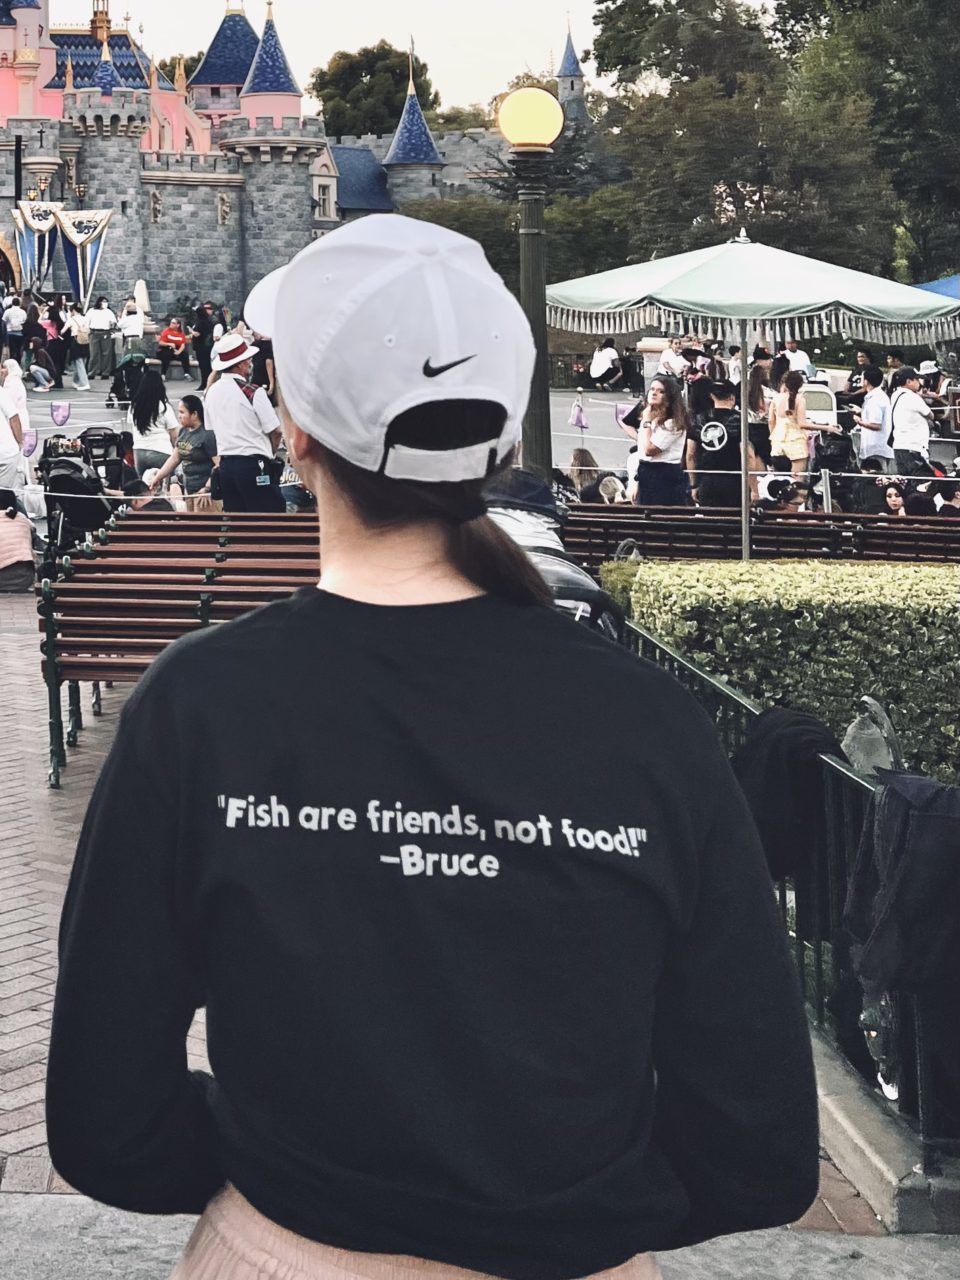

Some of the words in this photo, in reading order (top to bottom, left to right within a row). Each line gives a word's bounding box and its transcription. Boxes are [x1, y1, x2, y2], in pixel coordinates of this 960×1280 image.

[217, 794, 290, 828] "Fish
[298, 805, 358, 831] are
[366, 799, 486, 842] friends,
[494, 814, 553, 847] not
[560, 818, 647, 858] food!"
